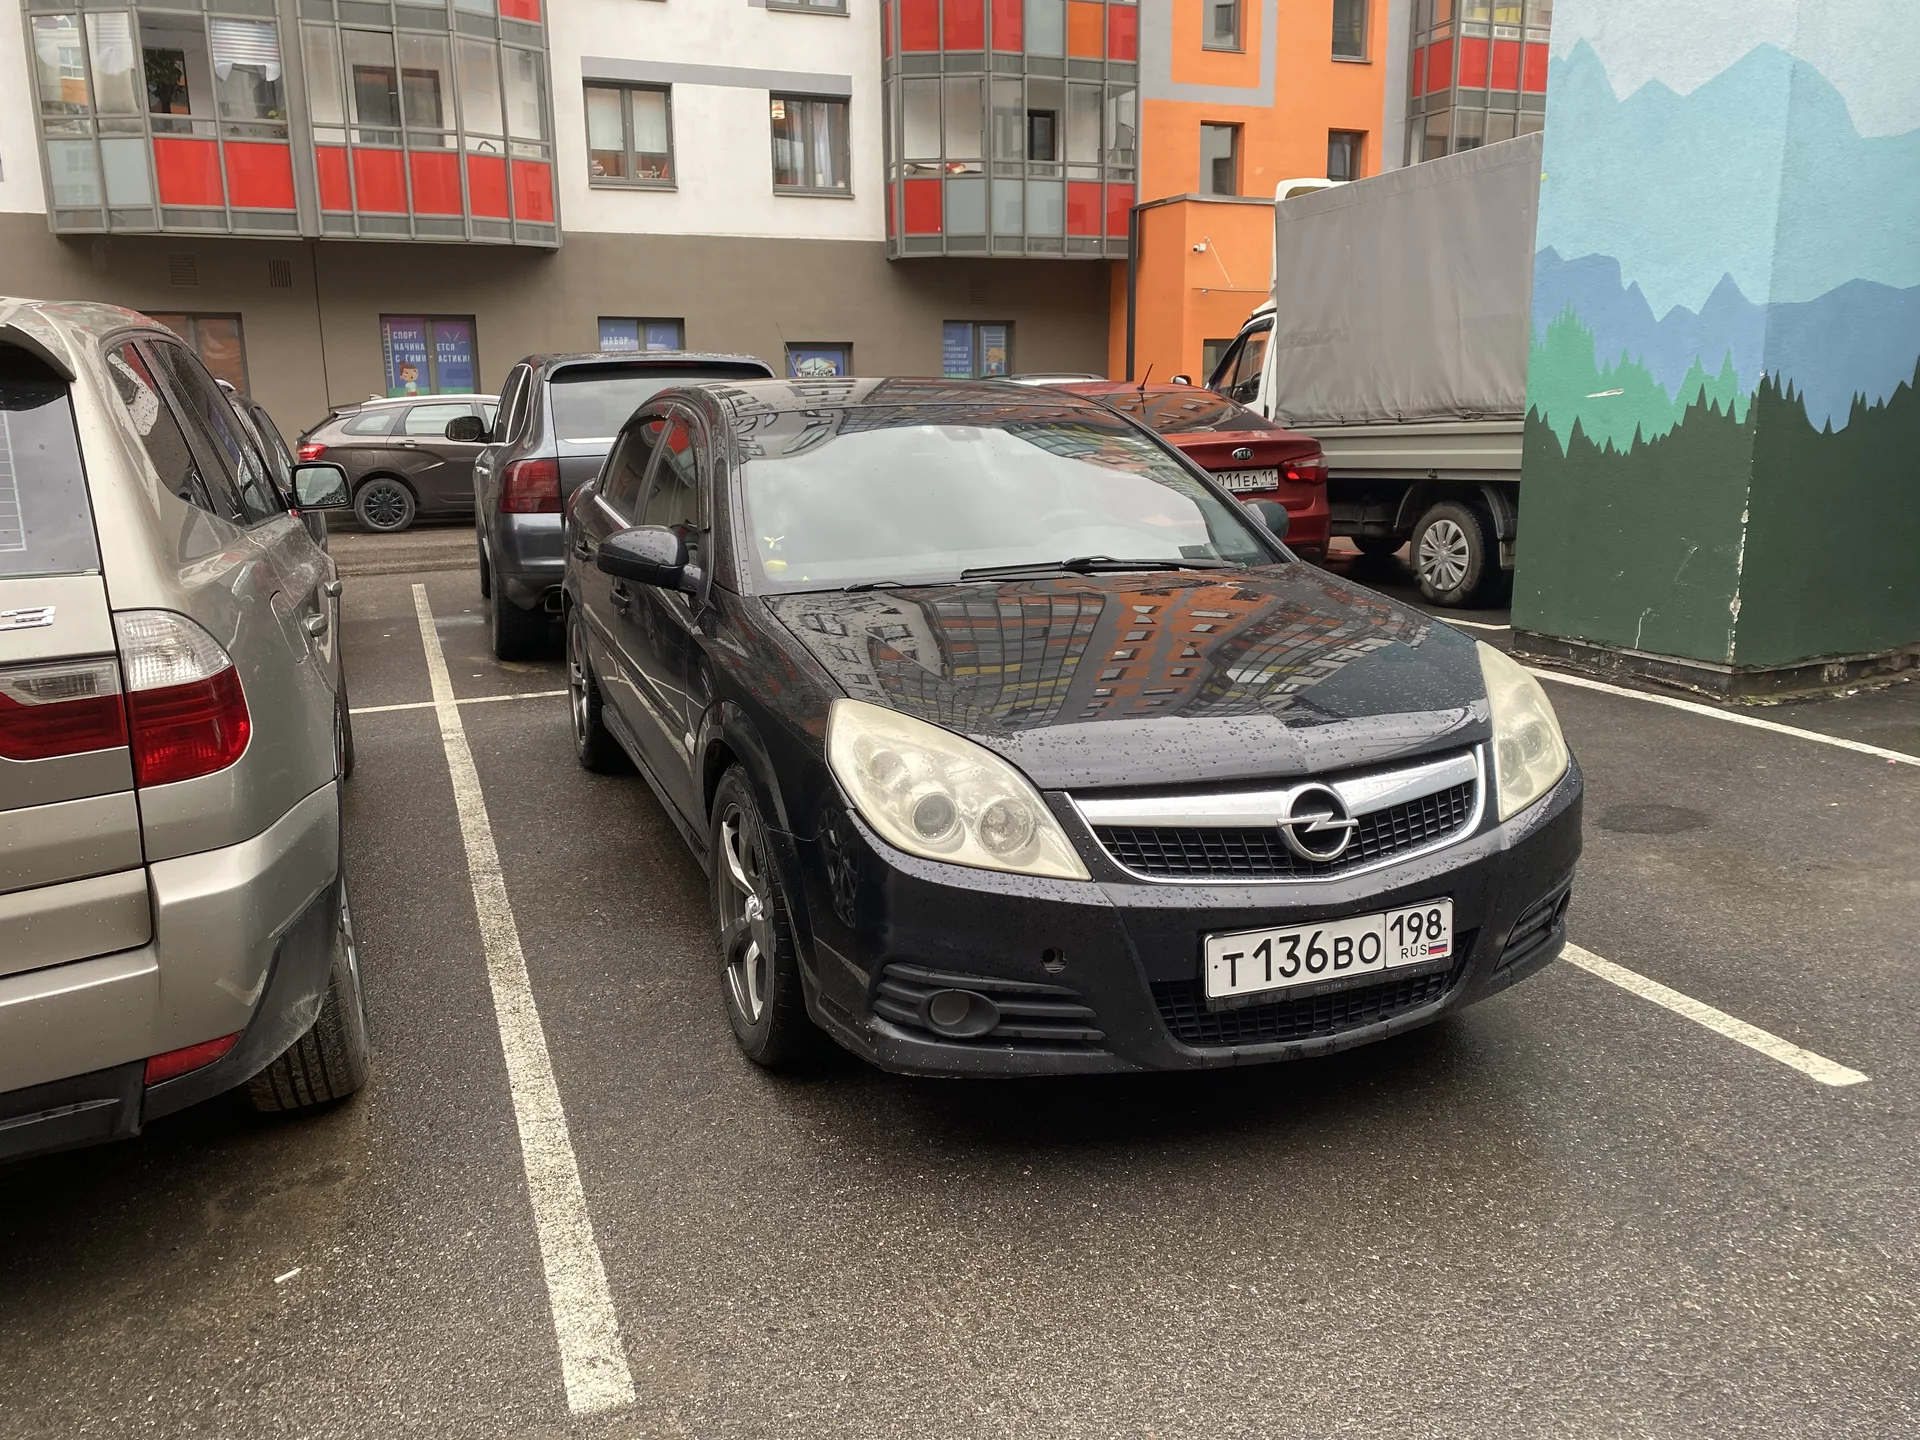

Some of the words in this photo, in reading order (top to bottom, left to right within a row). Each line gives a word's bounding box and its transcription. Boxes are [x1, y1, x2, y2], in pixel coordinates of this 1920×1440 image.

[393, 331, 417, 340] СПОРТ
[395, 354, 400, 363] С
[1236, 450, 1252, 459] KIA
[1262, 470, 1274, 482] 11
[1222, 930, 1382, 987] Т136ВО
[1389, 908, 1442, 947] 198
[1400, 944, 1428, 960] RUS
